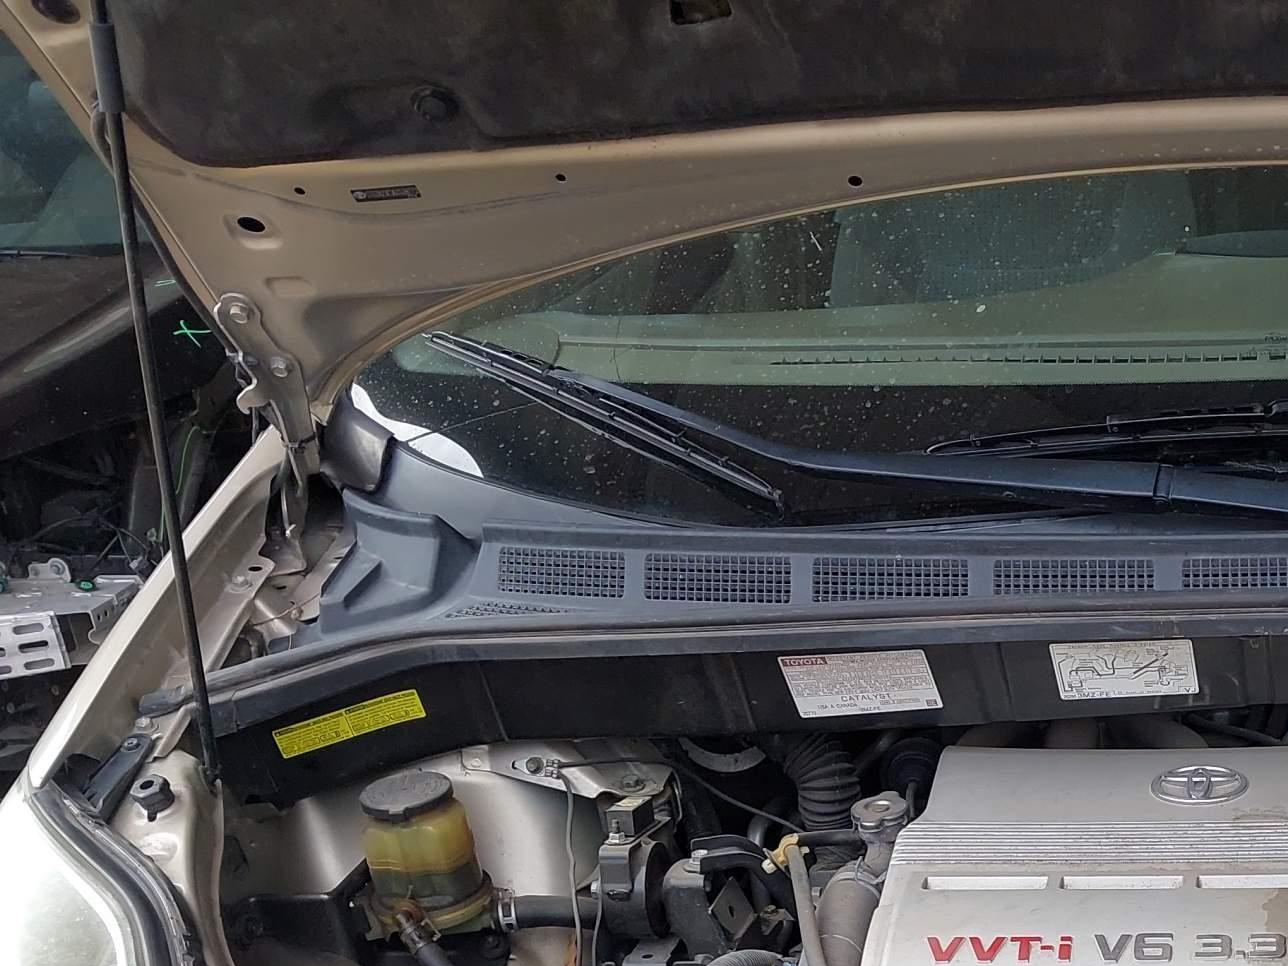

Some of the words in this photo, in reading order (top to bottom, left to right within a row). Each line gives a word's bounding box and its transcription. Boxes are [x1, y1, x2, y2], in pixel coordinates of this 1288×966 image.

[783, 658, 825, 666] TOYOTA
[841, 693, 892, 703] CATALYST
[927, 936, 1073, 964] VVT-i
[1094, 933, 1174, 964] V6
[1195, 934, 1288, 960] 3.3
